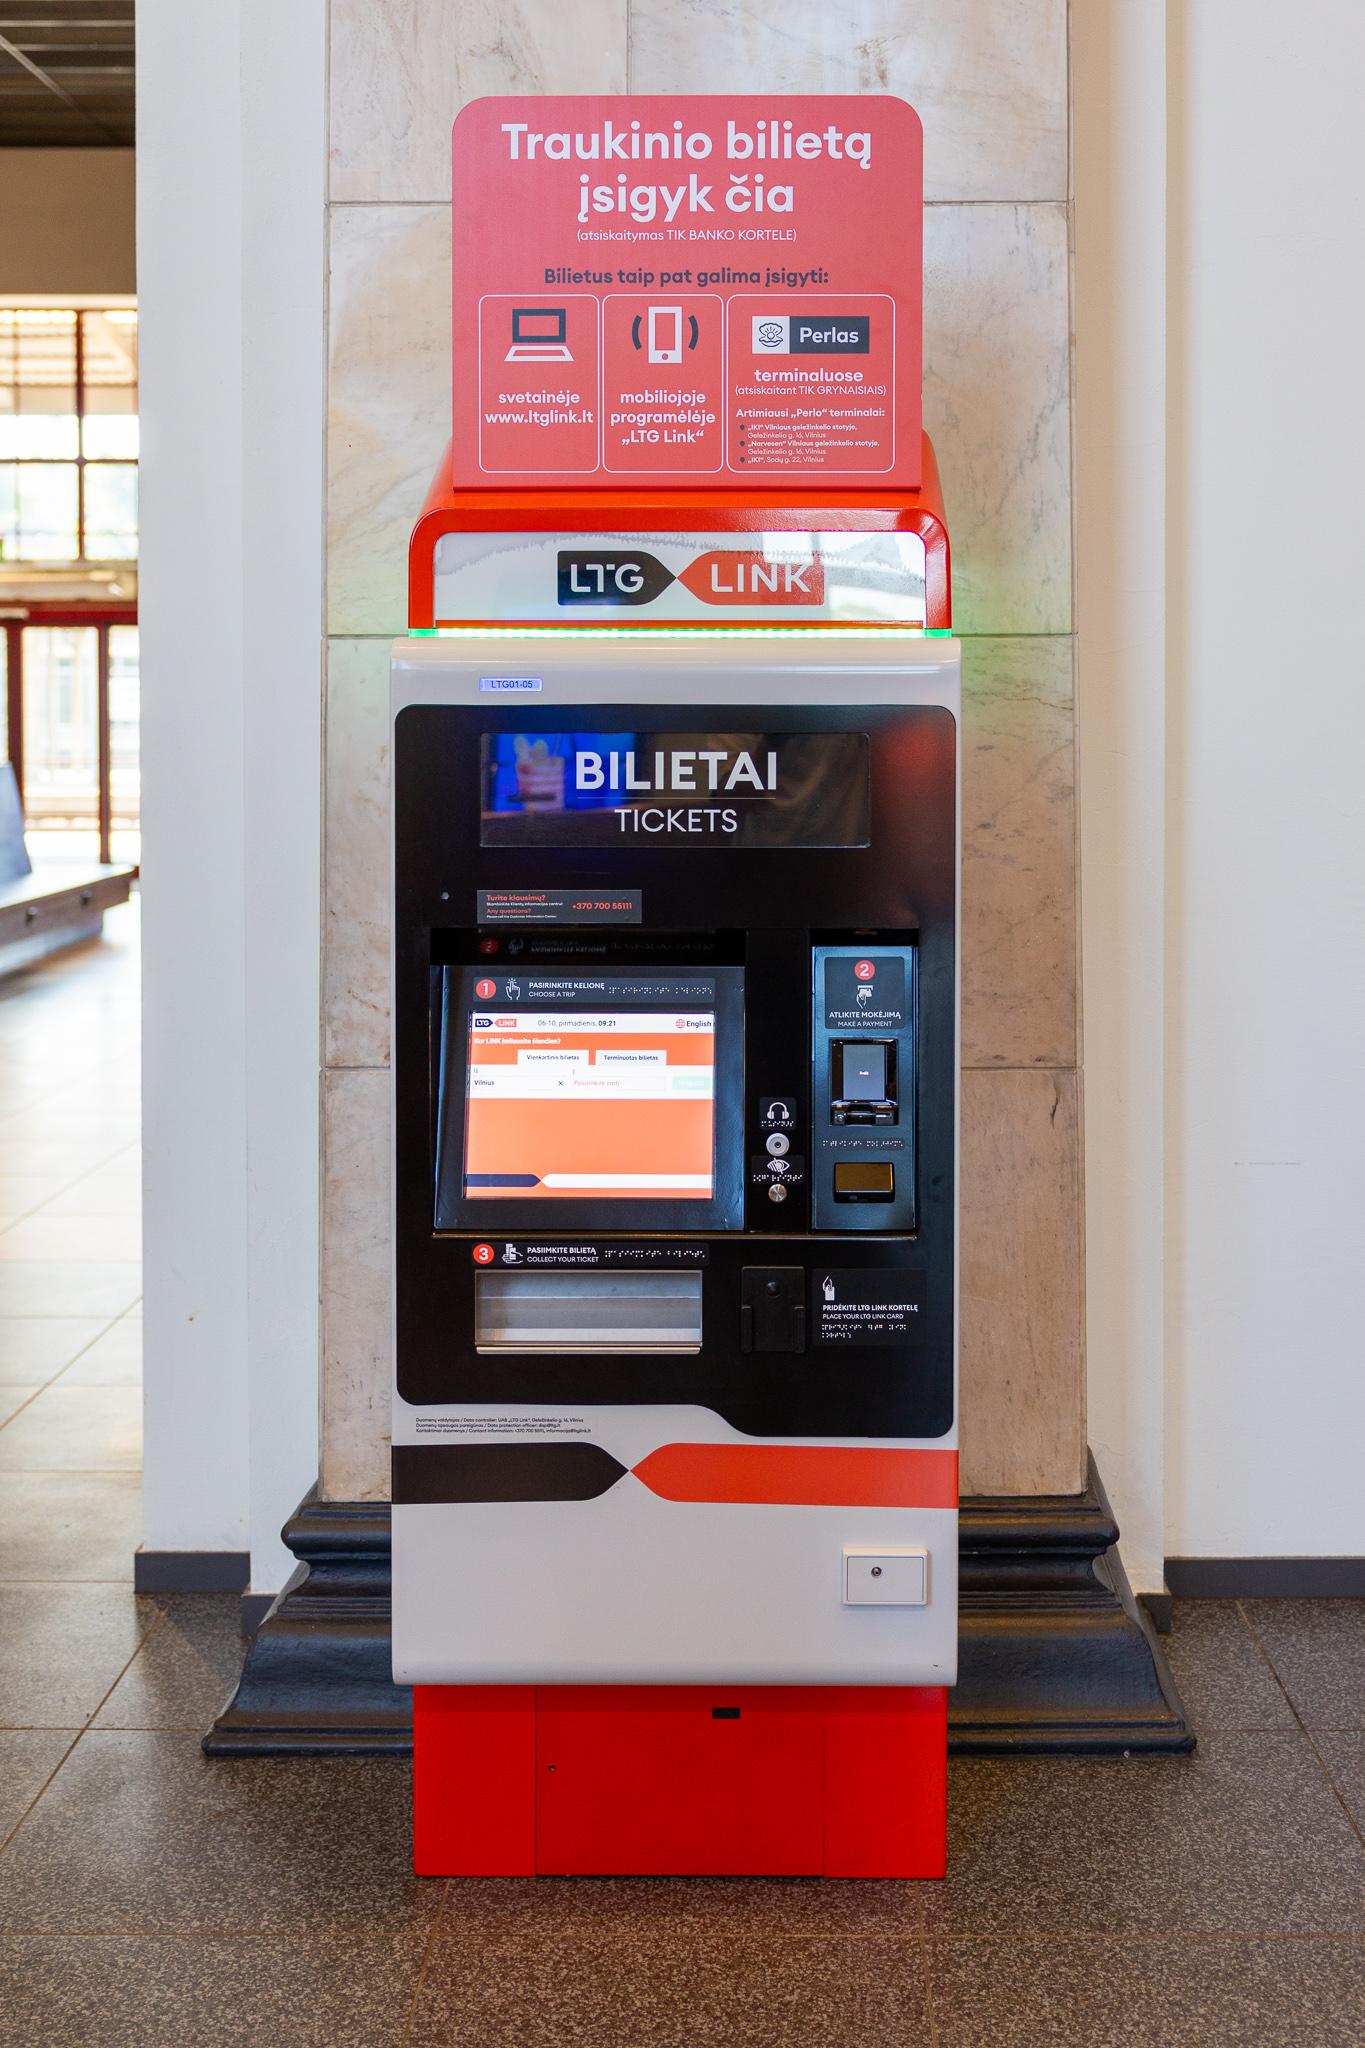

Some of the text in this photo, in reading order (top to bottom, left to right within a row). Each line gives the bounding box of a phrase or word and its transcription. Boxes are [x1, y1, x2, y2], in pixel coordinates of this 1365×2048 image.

[501, 120, 872, 169] Traukinio bilietą
[577, 173, 794, 223] įsigyk čia
[576, 229, 797, 242] (atsiskaitymas TIK BANKO KORTELE)
[544, 267, 829, 287] Bilietus taip pat galima įsigyti:
[800, 327, 859, 343] Perlas
[754, 368, 863, 382] terminaluose
[735, 385, 886, 396] (atsiskaitant TIK GRYNAISIAIS)
[498, 390, 580, 406] svetainėje
[620, 390, 706, 406] mobiliojoje
[484, 410, 593, 426] www.ltglink.lt
[610, 410, 715, 426] programėlėje
[736, 408, 885, 418] Artimiausi „Perlo“ terminalai:
[622, 430, 704, 445] „LTG Link“
[570, 563, 811, 593] LTG LINK
[491, 680, 533, 689] LTG01-05
[575, 751, 777, 790] BILIETAI
[614, 808, 738, 832] TICKETS
[509, 894, 546, 902] klausimų?
[572, 902, 632, 910] +370 700 55111
[859, 963, 870, 977] 2
[483, 983, 489, 996] 1
[573, 982, 605, 990] KELIONĘ
[861, 1010, 902, 1019] MOKĖJIMĄ
[558, 1020, 597, 1028] pirmadienis,
[686, 1020, 712, 1028] English
[478, 1247, 489, 1261] 3
[569, 1247, 596, 1255] BILIETĄ
[822, 1303, 857, 1311] PRIDĖKITE
[888, 1304, 918, 1312] KORTELĘ
